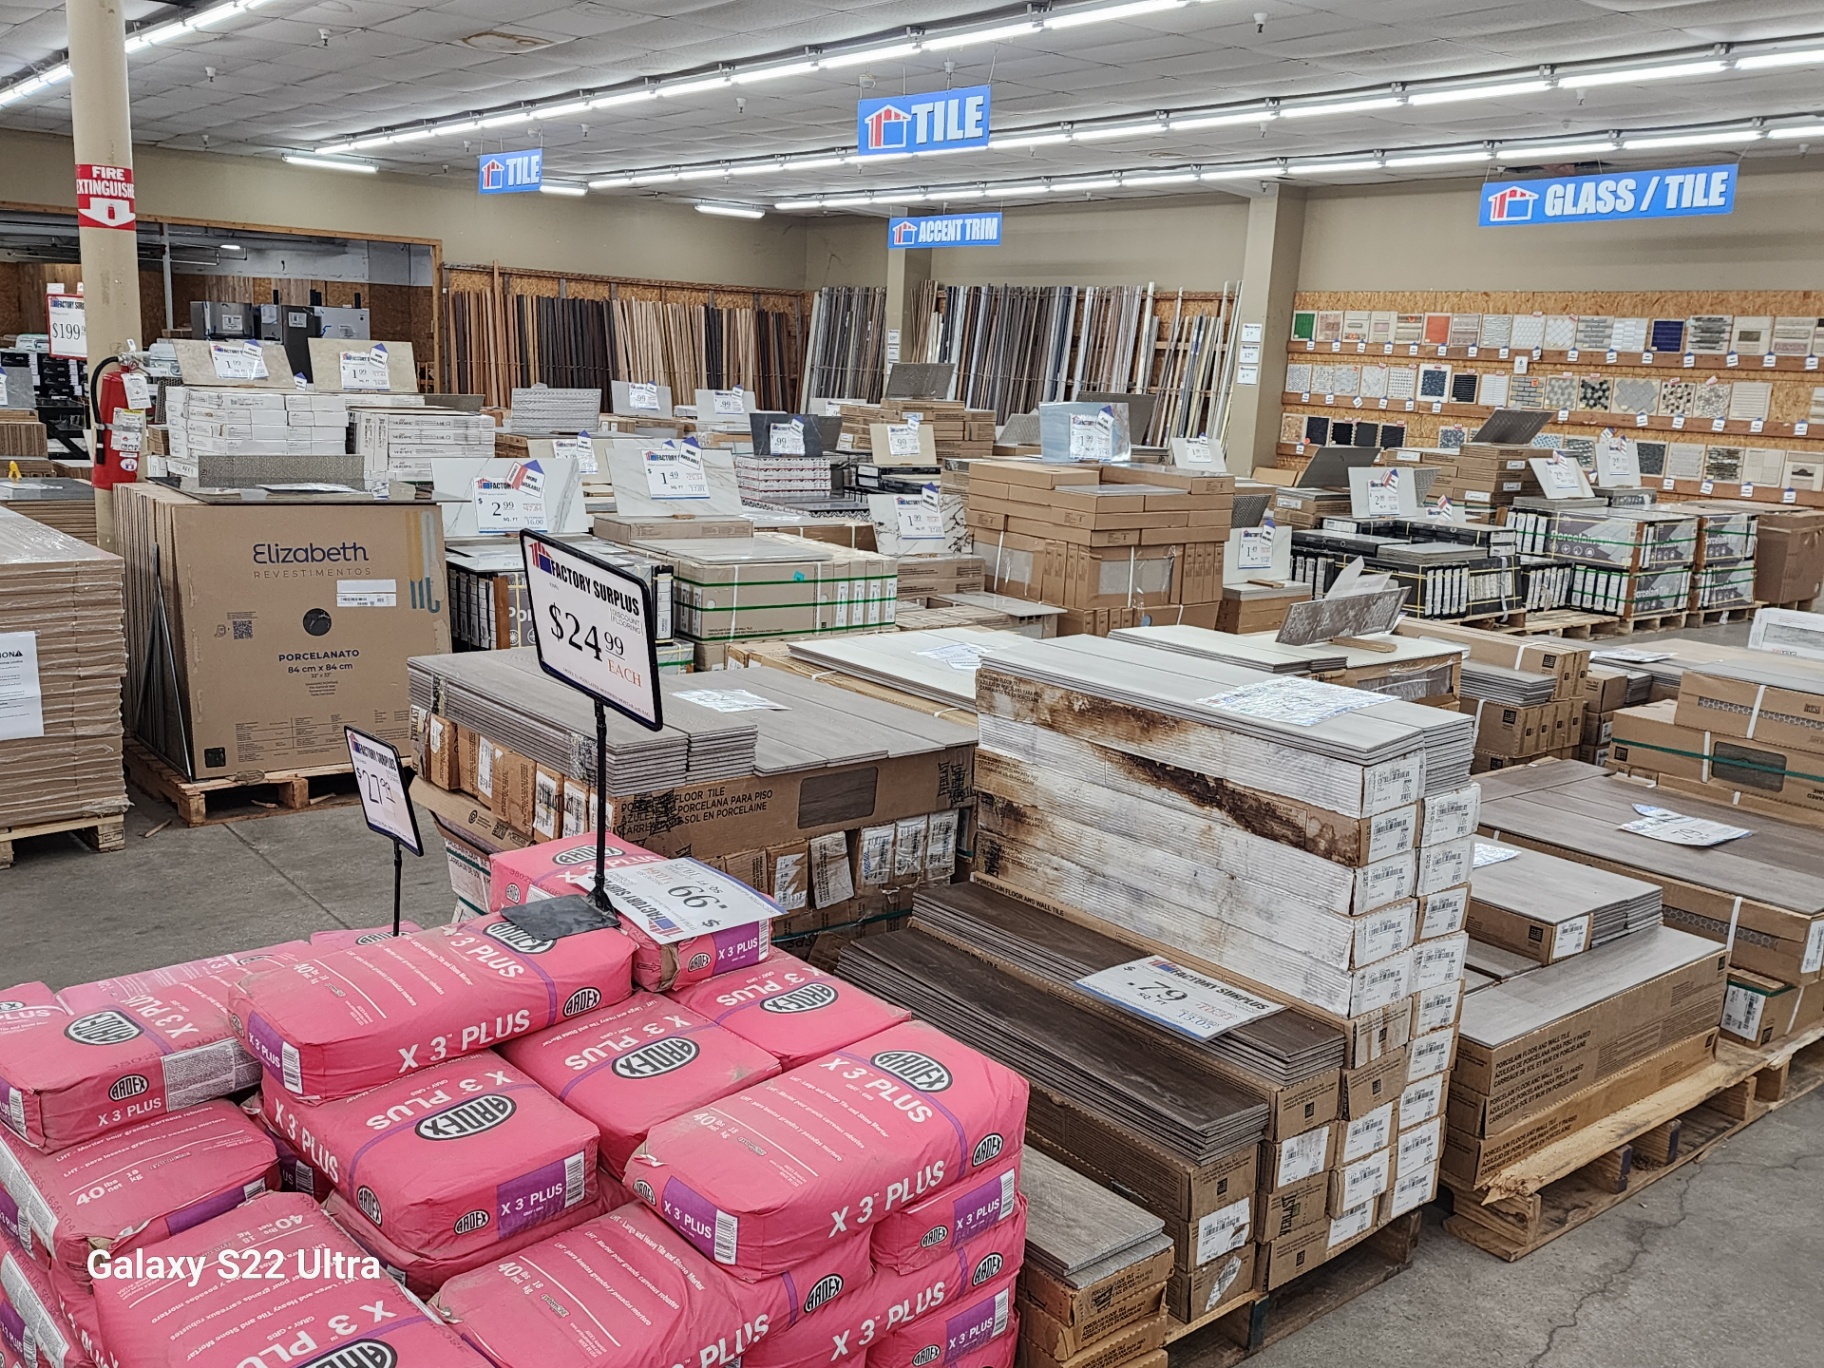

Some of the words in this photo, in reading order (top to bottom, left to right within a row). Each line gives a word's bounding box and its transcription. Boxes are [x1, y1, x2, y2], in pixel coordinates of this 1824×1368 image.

[910, 96, 984, 144] TILE
[91, 165, 125, 181] FIRE
[505, 154, 541, 187] TILE
[1544, 178, 1637, 217] GLASS
[1639, 176, 1660, 212] /
[1665, 171, 1729, 210] TILE
[917, 219, 963, 243] ACCENT
[964, 216, 998, 241] TRIM
[52, 322, 81, 341] $199
[660, 472, 667, 484] 1
[491, 501, 502, 517] 2
[502, 501, 515, 510] 99
[252, 542, 369, 565] Elizabeth
[253, 567, 372, 579] REVESTIMENTOS
[551, 559, 591, 595] FACTORY
[593, 581, 640, 617] SURPLUS
[278, 649, 360, 662] PORCELANATO
[288, 666, 300, 674] 84
[302, 665, 316, 673] cm
[325, 663, 338, 671] 84
[607, 659, 643, 688] EACH
[375, 751, 397, 772] SURPLUS
[674, 791, 704, 803] FLOOR
[707, 786, 726, 798] TILE
[678, 795, 729, 815] PORCELANA
[730, 793, 753, 804] PARA
[754, 789, 773, 801] PISO
[684, 812, 701, 825] SOL
[703, 810, 714, 822] EN
[716, 801, 768, 819] PORCELAINE
[630, 893, 666, 921] FACTORY
[976, 876, 1006, 894] PORCELAIN
[1004, 888, 1024, 901] FLOOR
[1023, 895, 1036, 906] AND
[1035, 900, 1052, 913] WALL
[1051, 906, 1065, 917] TILE
[736, 937, 759, 954] PLUS
[465, 943, 526, 980] PLUS
[689, 952, 711, 972] ARDEX
[564, 988, 601, 1016] ARDEX
[715, 980, 786, 1008] PLUS
[762, 983, 836, 1012] ARDEX
[1171, 969, 1221, 990] FACTORY
[1215, 985, 1271, 1011] SURPLUS
[460, 1008, 531, 1052] PLUS
[261, 1044, 281, 1069] PLUS
[564, 1033, 641, 1072] PLUS
[616, 1036, 696, 1078] ARDEX
[1493, 1070, 1520, 1089] CARREAUX
[1526, 1062, 1537, 1073] SOL
[1559, 1039, 1587, 1060] PORCELAINE
[1495, 1053, 1523, 1071] PORCELAIN
[1522, 1044, 1539, 1058] FLOOR
[1537, 1040, 1549, 1052] AND
[1548, 1035, 1561, 1046] WALL
[1560, 1030, 1571, 1041] TILE
[1522, 1049, 1551, 1067] PORCELANA
[1550, 1042, 1564, 1054] PARA
[1562, 1037, 1574, 1048] PISO
[874, 1051, 950, 1091] ARDEX
[1552, 1073, 1580, 1094] PORCELAINE
[110, 1074, 148, 1101] ARDEX
[1489, 1087, 1516, 1106] PORCELAIN
[1515, 1080, 1531, 1093] FLOOR
[1530, 1075, 1542, 1086] AND
[1553, 1065, 1564, 1075] TILE
[1516, 1083, 1544, 1102] PORCELANA
[1543, 1077, 1556, 1088] PARA
[126, 1097, 162, 1118] PLUS
[366, 1089, 454, 1131] PLUS
[867, 1076, 933, 1124] PLUS
[420, 1094, 512, 1140] ARDEX
[692, 1111, 718, 1127] 40
[301, 1126, 340, 1184] PLUS
[973, 1134, 1002, 1166] ARDEX
[75, 1185, 106, 1207] 40
[103, 1177, 119, 1189] lbs
[129, 1174, 143, 1184] kg
[884, 1160, 946, 1212] PLUS
[357, 1186, 382, 1226] ARDEX
[529, 1182, 564, 1206] PLUS
[275, 1213, 304, 1230] 40
[456, 1209, 489, 1235] ARDEX
[974, 1197, 1001, 1222] PLUS
[683, 1213, 713, 1240] PLUS
[921, 1225, 948, 1248] ARDEX
[498, 1261, 524, 1278] 40
[664, 1250, 677, 1263] and
[973, 1253, 1002, 1285] ARDEX
[805, 1274, 843, 1313] ARDEX
[886, 1281, 946, 1331] PLUS
[968, 1316, 994, 1340] PLUS
[913, 1344, 940, 1367] ARDEX
